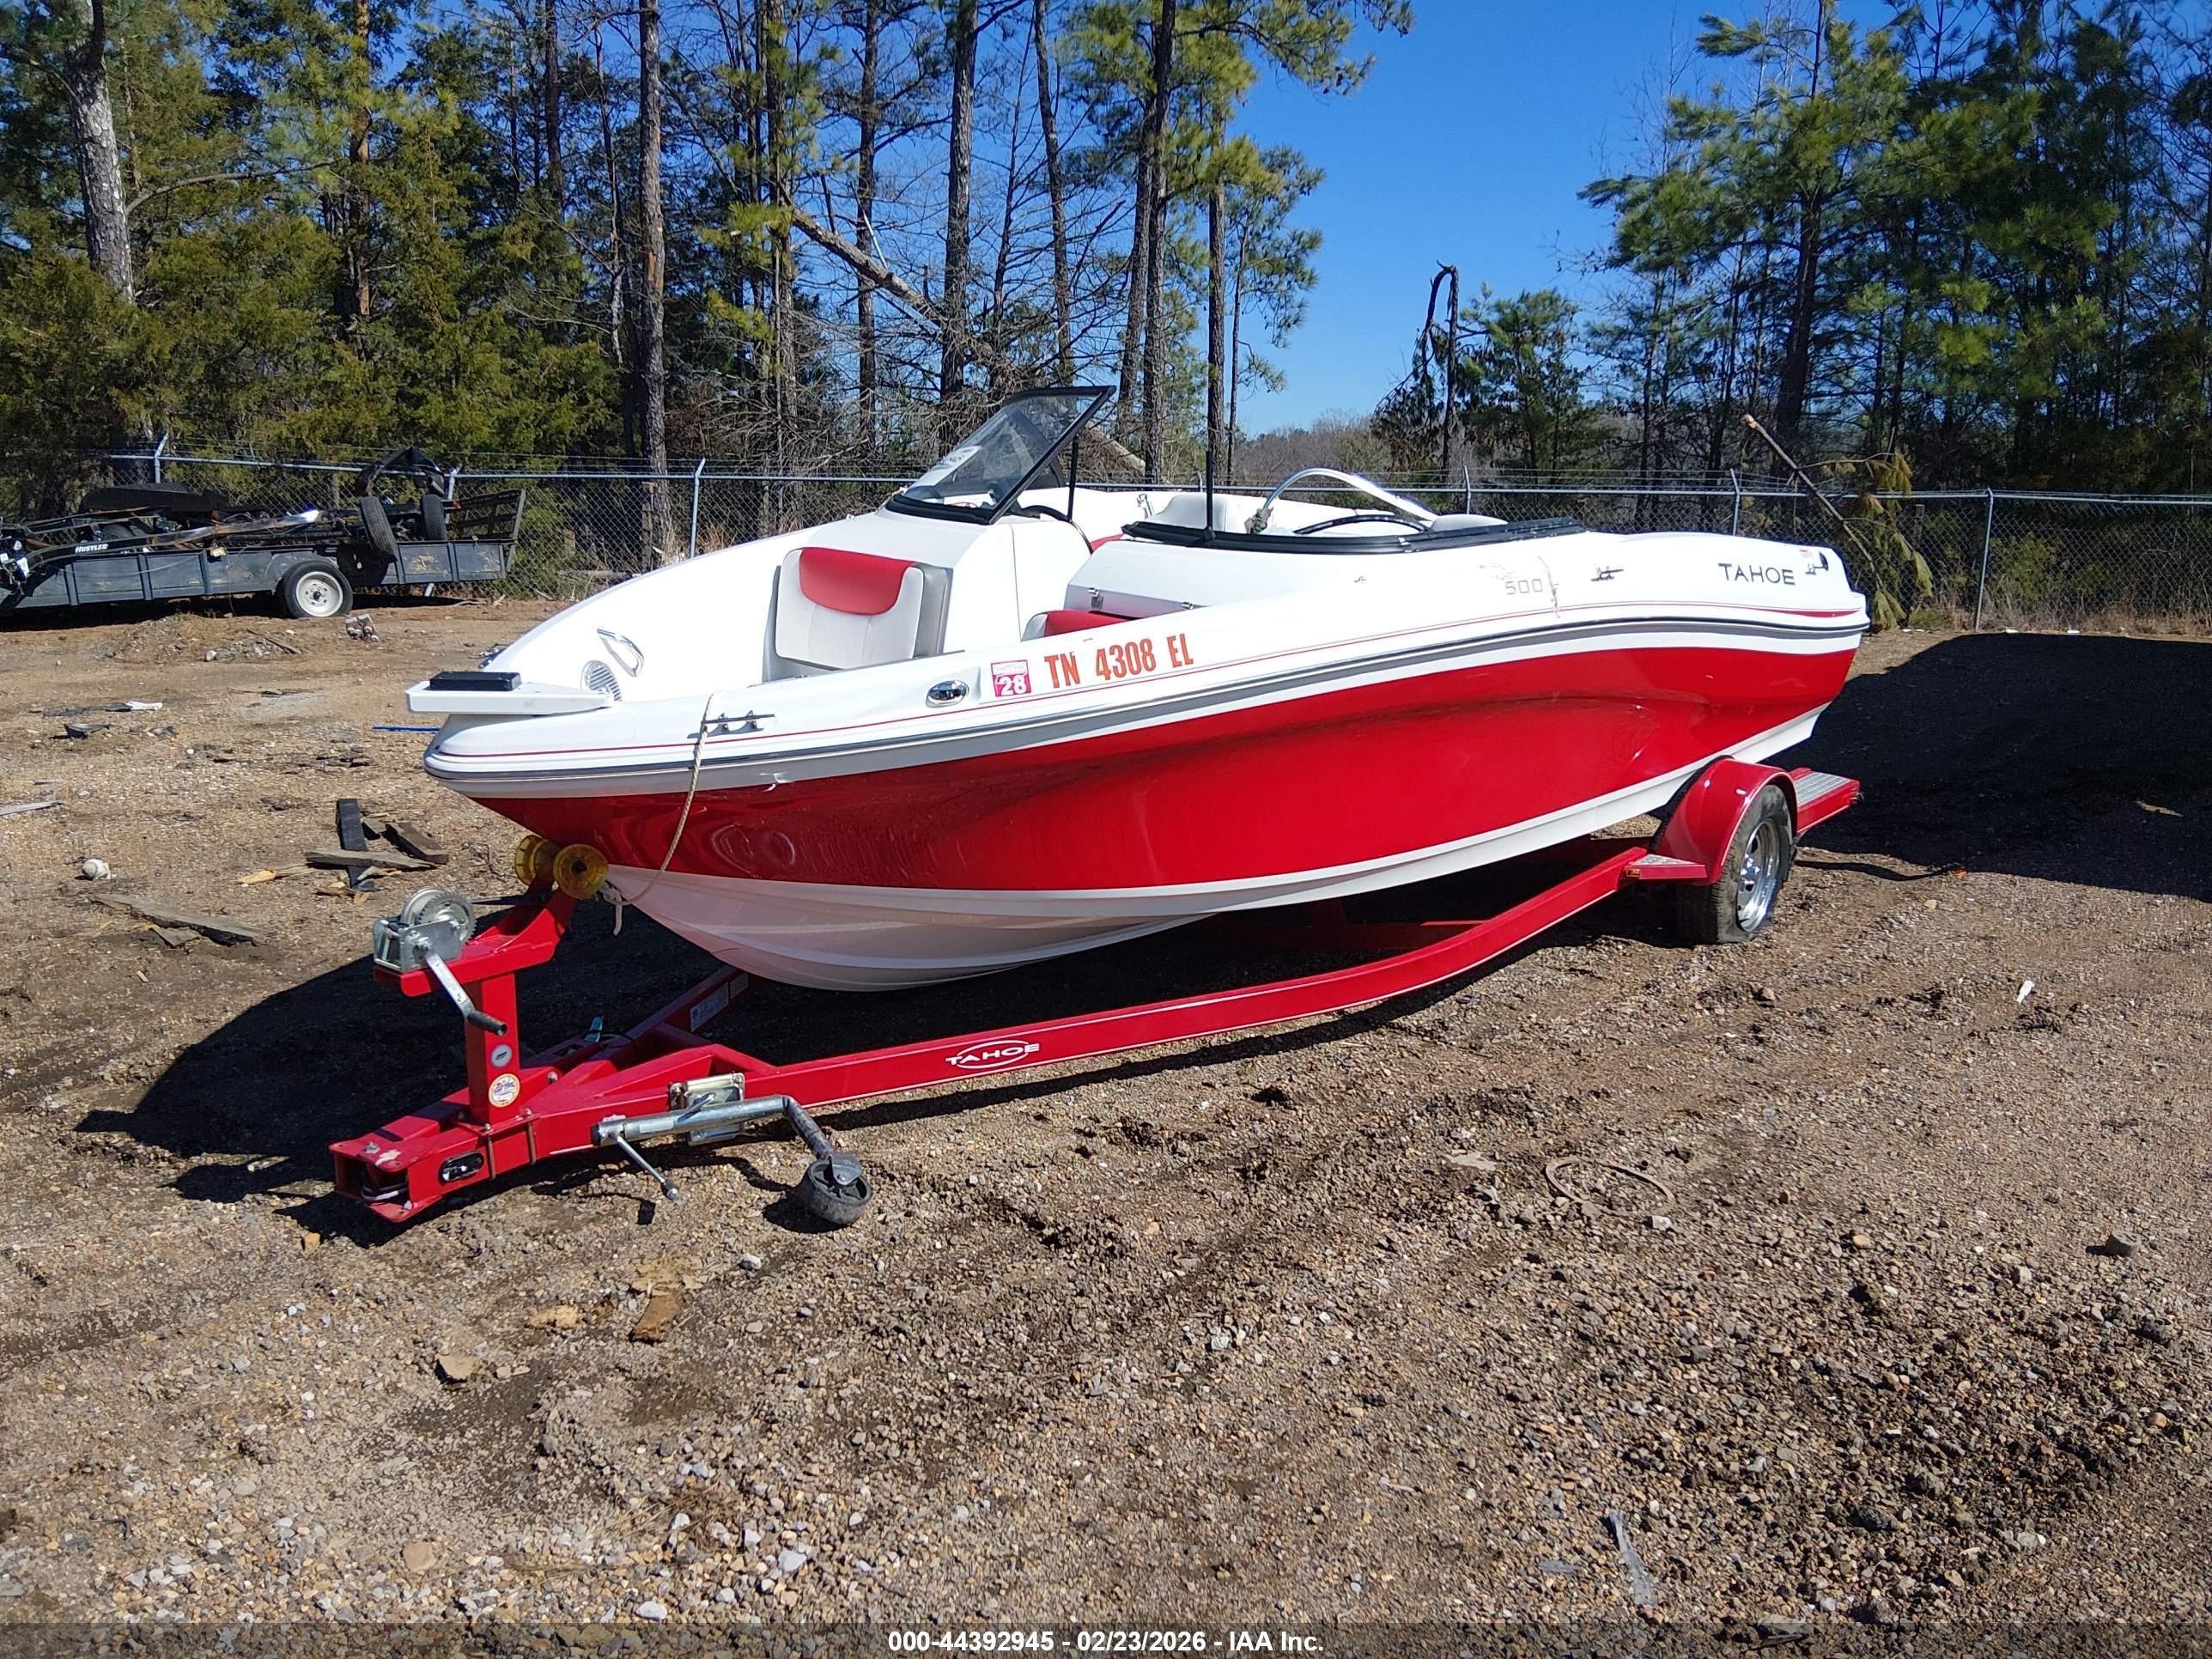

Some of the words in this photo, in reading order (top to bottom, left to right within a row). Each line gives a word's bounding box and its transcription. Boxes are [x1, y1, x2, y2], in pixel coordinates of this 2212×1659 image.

[75, 544, 109, 553] HUSTLER
[1717, 562, 1796, 586] TAHOE
[1504, 578, 1543, 595] 500
[1044, 652, 1080, 688] TN
[1096, 638, 1157, 680] 4308
[1166, 633, 1194, 668] EL
[995, 674, 1028, 696] 28
[945, 1043, 1040, 1066] TAHOE
